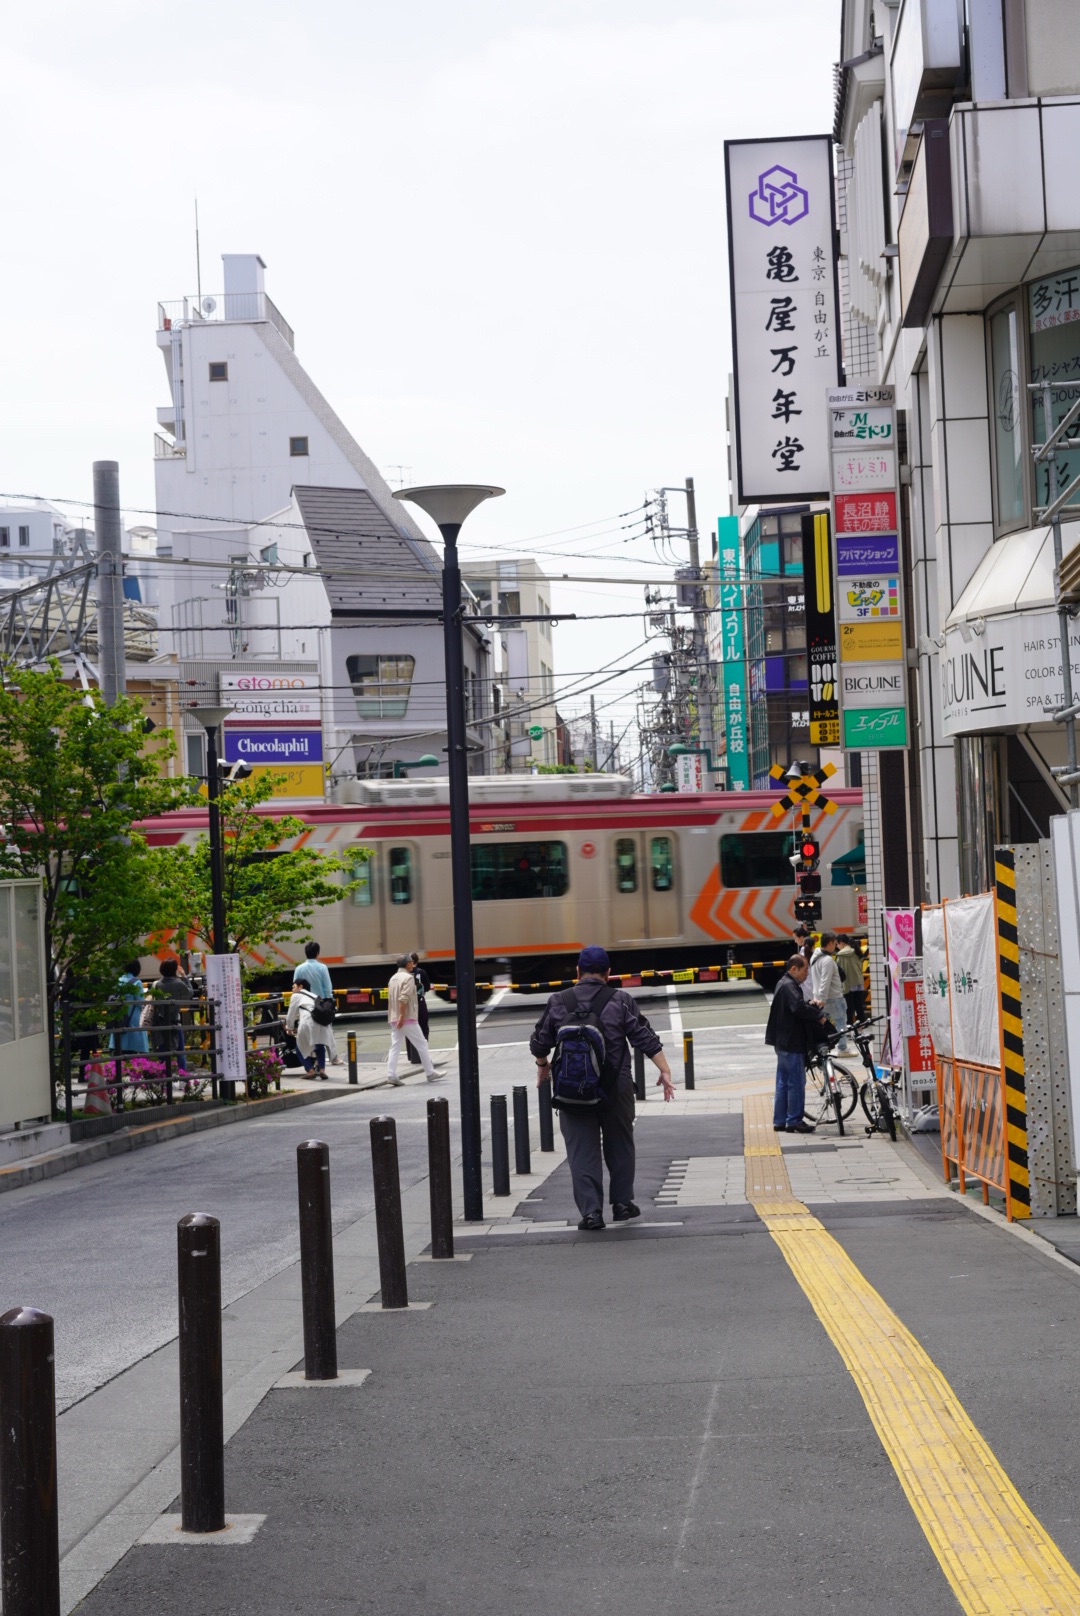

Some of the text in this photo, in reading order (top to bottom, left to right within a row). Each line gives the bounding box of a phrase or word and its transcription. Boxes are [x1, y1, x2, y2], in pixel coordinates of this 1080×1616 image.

[812, 246, 830, 358] 東京 自由が丘
[765, 245, 805, 472] 亀屋万年堂
[856, 390, 893, 402] ミドリビル
[833, 411, 845, 421] 7F
[855, 424, 891, 439] ミドリ
[847, 461, 887, 474] キレミカ
[844, 518, 890, 532] きもの学院
[839, 547, 894, 560] アパマンショップ
[851, 581, 880, 589] 不動産の
[722, 548, 740, 661] 東進ハイスクール
[847, 589, 885, 607] ビッグ
[856, 608, 870, 617] 3F
[843, 626, 854, 635] 2F
[1024, 639, 1045, 652] HAIR
[1025, 666, 1056, 680] COLOR
[237, 677, 305, 690] etomo
[845, 675, 901, 691] BIGUINE
[1026, 696, 1043, 708] SPA
[1045, 694, 1053, 706] &
[234, 701, 272, 718] Gong
[274, 700, 298, 714] cha
[729, 683, 744, 753] 自由が丘校
[854, 713, 900, 731] エイブル
[237, 738, 309, 756] Chocolaphil
